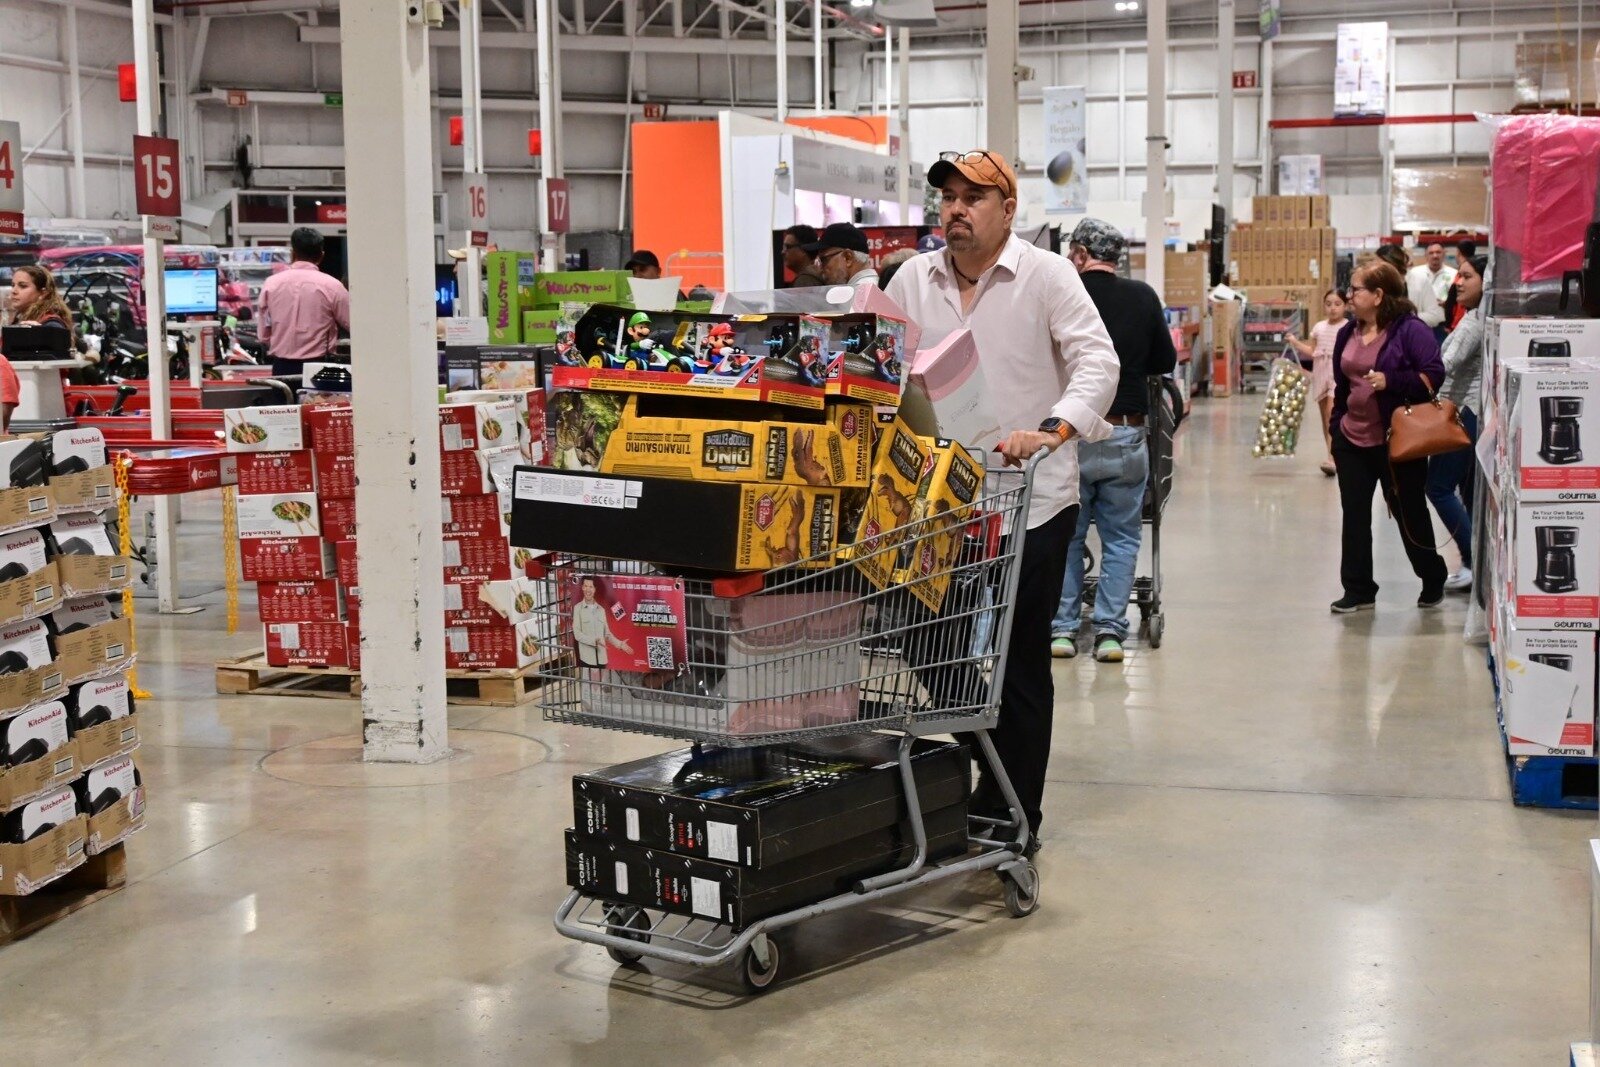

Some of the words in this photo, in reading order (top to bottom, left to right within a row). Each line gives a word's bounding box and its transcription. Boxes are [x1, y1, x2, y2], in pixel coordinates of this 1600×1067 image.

[141, 154, 173, 199] 15
[469, 186, 485, 218] 16
[551, 190, 566, 220] 17
[326, 210, 347, 219] Salid
[152, 223, 172, 232] Abierta
[259, 408, 298, 416] KitchenAid
[70, 436, 100, 446] KitchenAid
[626, 441, 691, 454] TIRANOSAURIO
[856, 408, 865, 482] TIRANOSAURIO
[705, 447, 750, 466] DINO
[766, 429, 779, 477] DINO
[198, 469, 218, 479] Carrito
[226, 467, 237, 475] Soc
[1558, 492, 1597, 500] Gourmia
[67, 518, 98, 528] KitchenAid
[745, 488, 756, 565] TIRANOSAURIO
[241, 529, 281, 537] KitchenAid
[7, 536, 39, 552] KitchenAid
[70, 601, 105, 613] KitchenAid
[636, 604, 671, 614] NOVIEMBRE
[631, 613, 678, 624] ESPECTACULAR
[3, 624, 41, 640] KitchenAid
[95, 681, 124, 695] KitchenAid
[28, 709, 62, 728] KitchenAid
[104, 760, 130, 777] KitchenAid
[40, 792, 71, 812] KitchenAid
